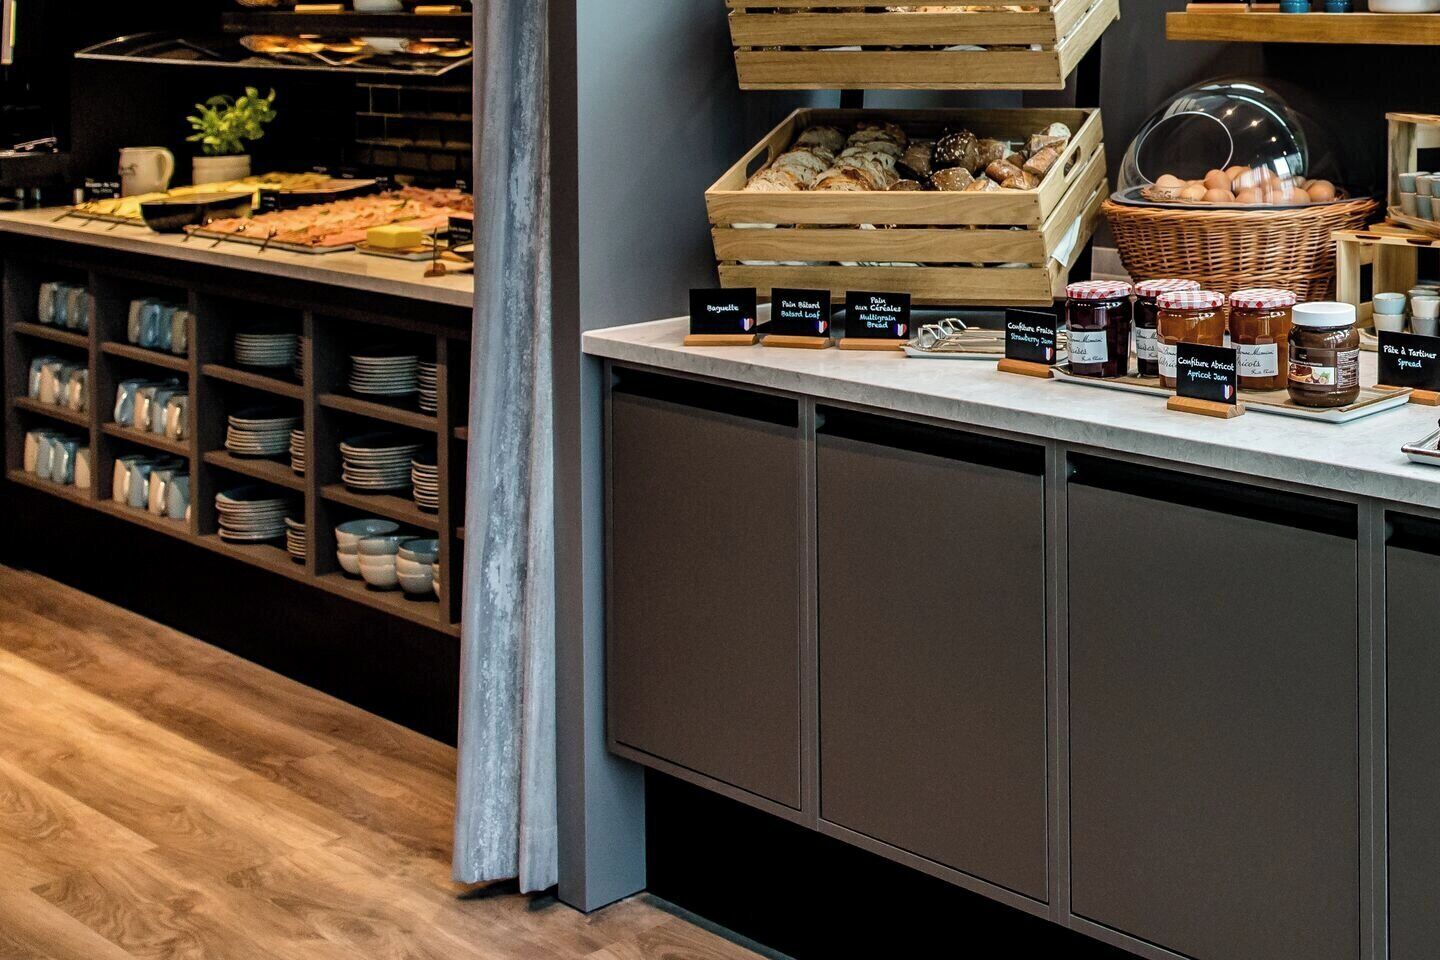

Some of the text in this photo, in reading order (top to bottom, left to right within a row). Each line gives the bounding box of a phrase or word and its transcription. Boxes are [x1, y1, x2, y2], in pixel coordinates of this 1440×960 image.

[782, 300, 796, 308] Pain
[870, 296, 886, 304] Pain
[707, 304, 739, 314] Baguette
[870, 304, 902, 312] Céréales
[805, 310, 820, 319] Loaf
[859, 313, 896, 323] Multigrain
[867, 321, 888, 329] Bread
[1007, 322, 1054, 335] Confiture Fraise
[1010, 332, 1053, 347] Strawberry Jam
[1383, 344, 1437, 359] Pâte à Tartiner
[1178, 356, 1235, 372] Confiture Abricot
[1397, 358, 1422, 371] Spread
[1187, 370, 1228, 382] Apricot Jam
